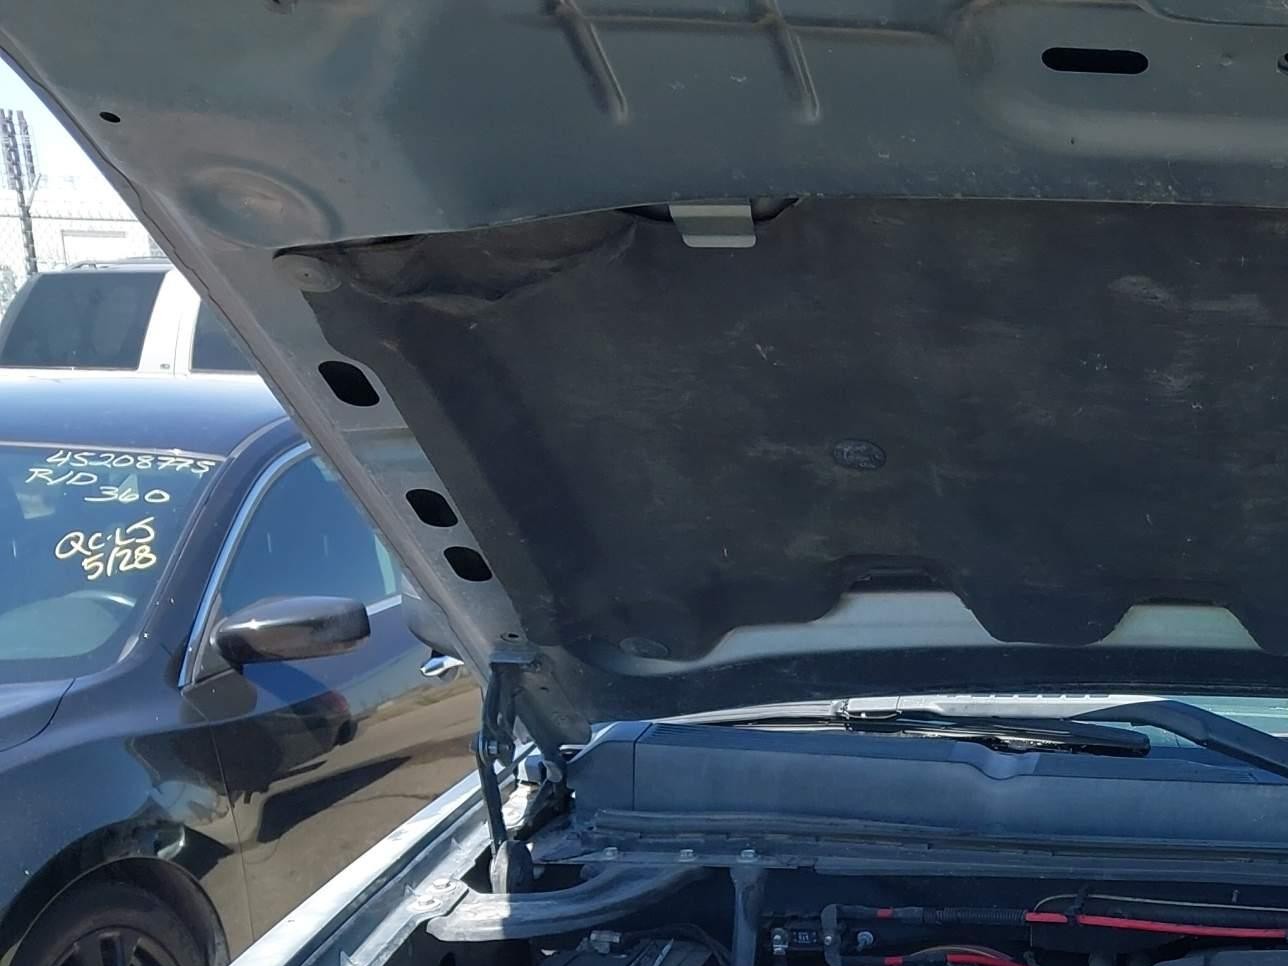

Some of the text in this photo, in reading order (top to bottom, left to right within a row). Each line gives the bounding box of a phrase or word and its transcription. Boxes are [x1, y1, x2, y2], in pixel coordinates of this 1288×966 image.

[46, 449, 215, 474] 45208775
[85, 486, 170, 502] 360
[81, 544, 157, 580] 5/28
